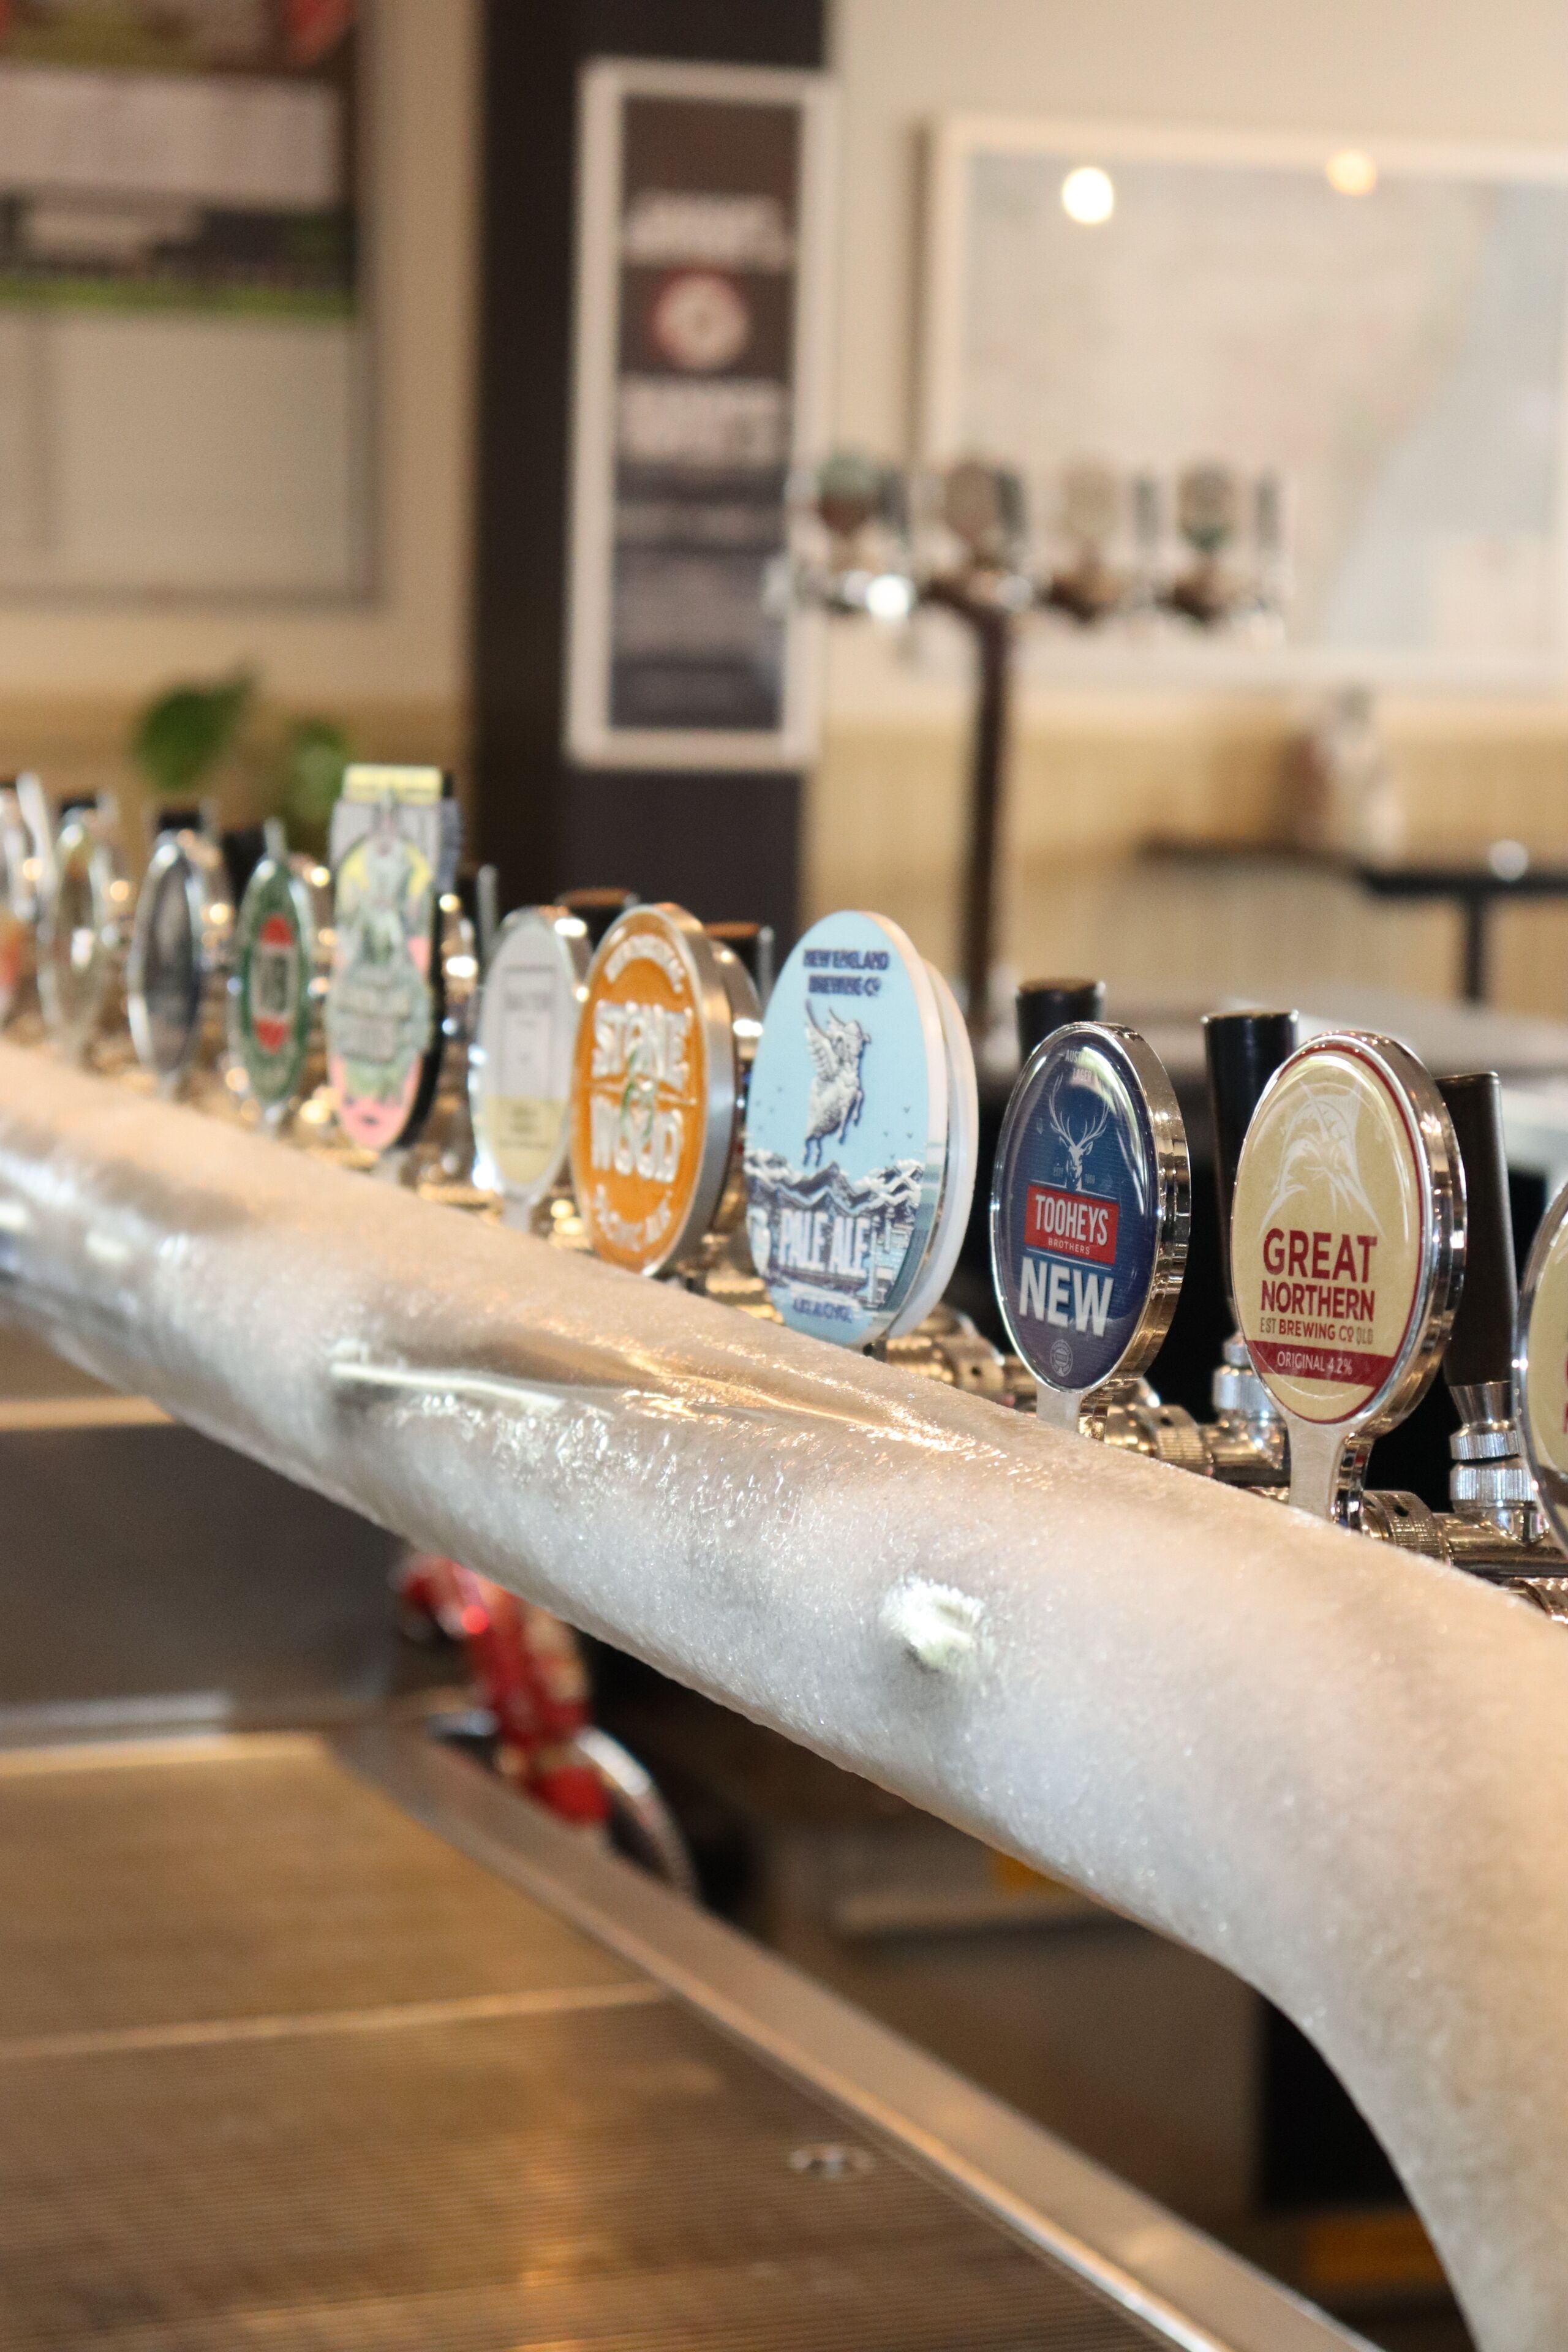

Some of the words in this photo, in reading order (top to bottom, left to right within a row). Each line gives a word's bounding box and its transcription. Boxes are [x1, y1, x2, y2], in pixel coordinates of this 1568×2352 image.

[1072, 1067, 1093, 1082] LAGER
[1035, 1194, 1109, 1246] TOOHEYS
[777, 1207, 828, 1272] PALE
[829, 1214, 870, 1279] ALE
[1048, 1237, 1091, 1255] BROTHERS
[1263, 1227, 1378, 1283] GREAT
[1019, 1256, 1114, 1337] NEW
[1261, 1280, 1375, 1322] NORTHERN
[1260, 1317, 1276, 1333] EST
[1278, 1318, 1336, 1340] BREWING
[1356, 1326, 1373, 1345] QLD
[1277, 1351, 1325, 1373] ORIGINAL
[1327, 1356, 1353, 1375] 4.2%
